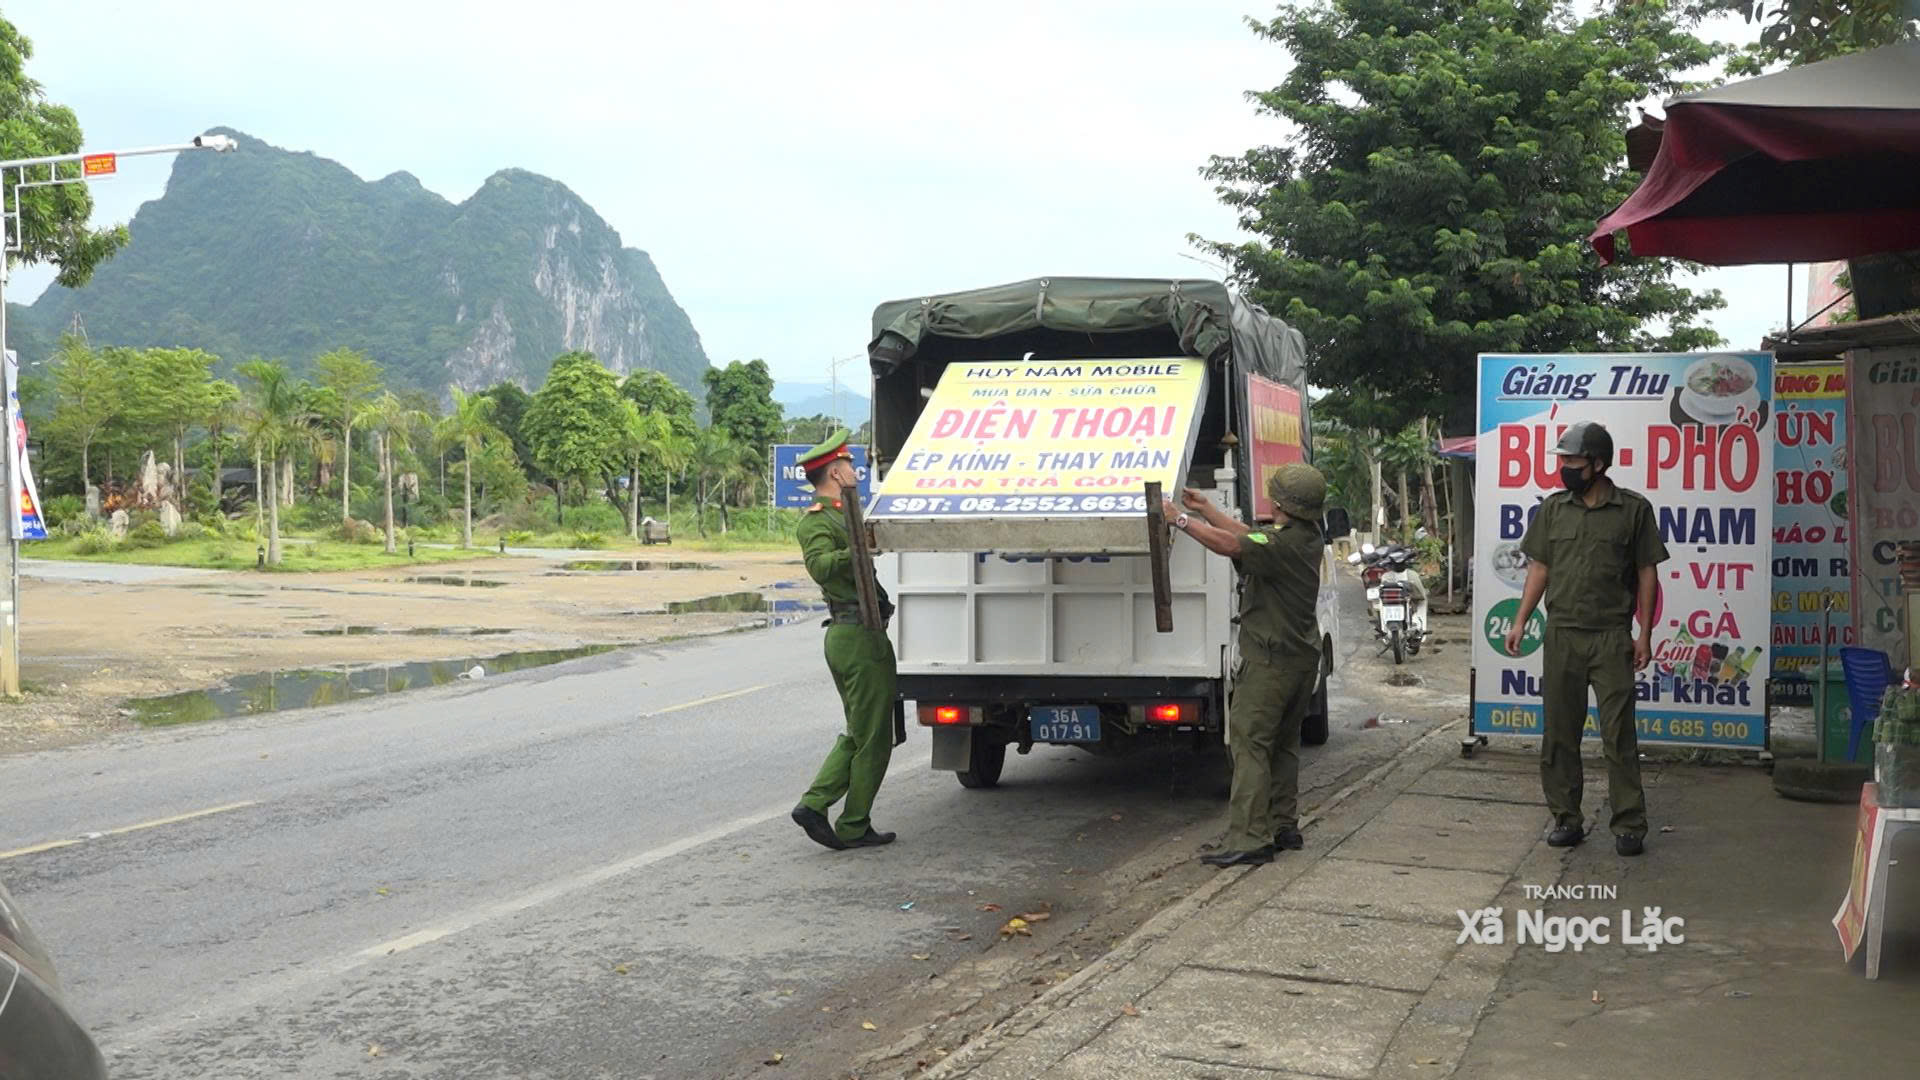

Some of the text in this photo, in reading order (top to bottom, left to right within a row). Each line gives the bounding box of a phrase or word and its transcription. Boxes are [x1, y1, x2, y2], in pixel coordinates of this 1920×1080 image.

[966, 364, 1181, 378] HUY NAM MOBILE
[1502, 363, 1670, 399] Giảng Thu
[931, 400, 1176, 445] ĐIỆN THOẠI
[948, 448, 1011, 471] KÍNH
[1038, 452, 1103, 471] THAY
[1647, 406, 1760, 493] PHỞ
[1660, 507, 1756, 553] NẠM
[1689, 562, 1754, 596] VỊT
[1688, 603, 1741, 640] GÀ
[1051, 709, 1079, 723] 36A
[1491, 707, 1537, 734] ĐIỆN
[1669, 719, 1704, 737] 685
[1711, 721, 1748, 739] 900
